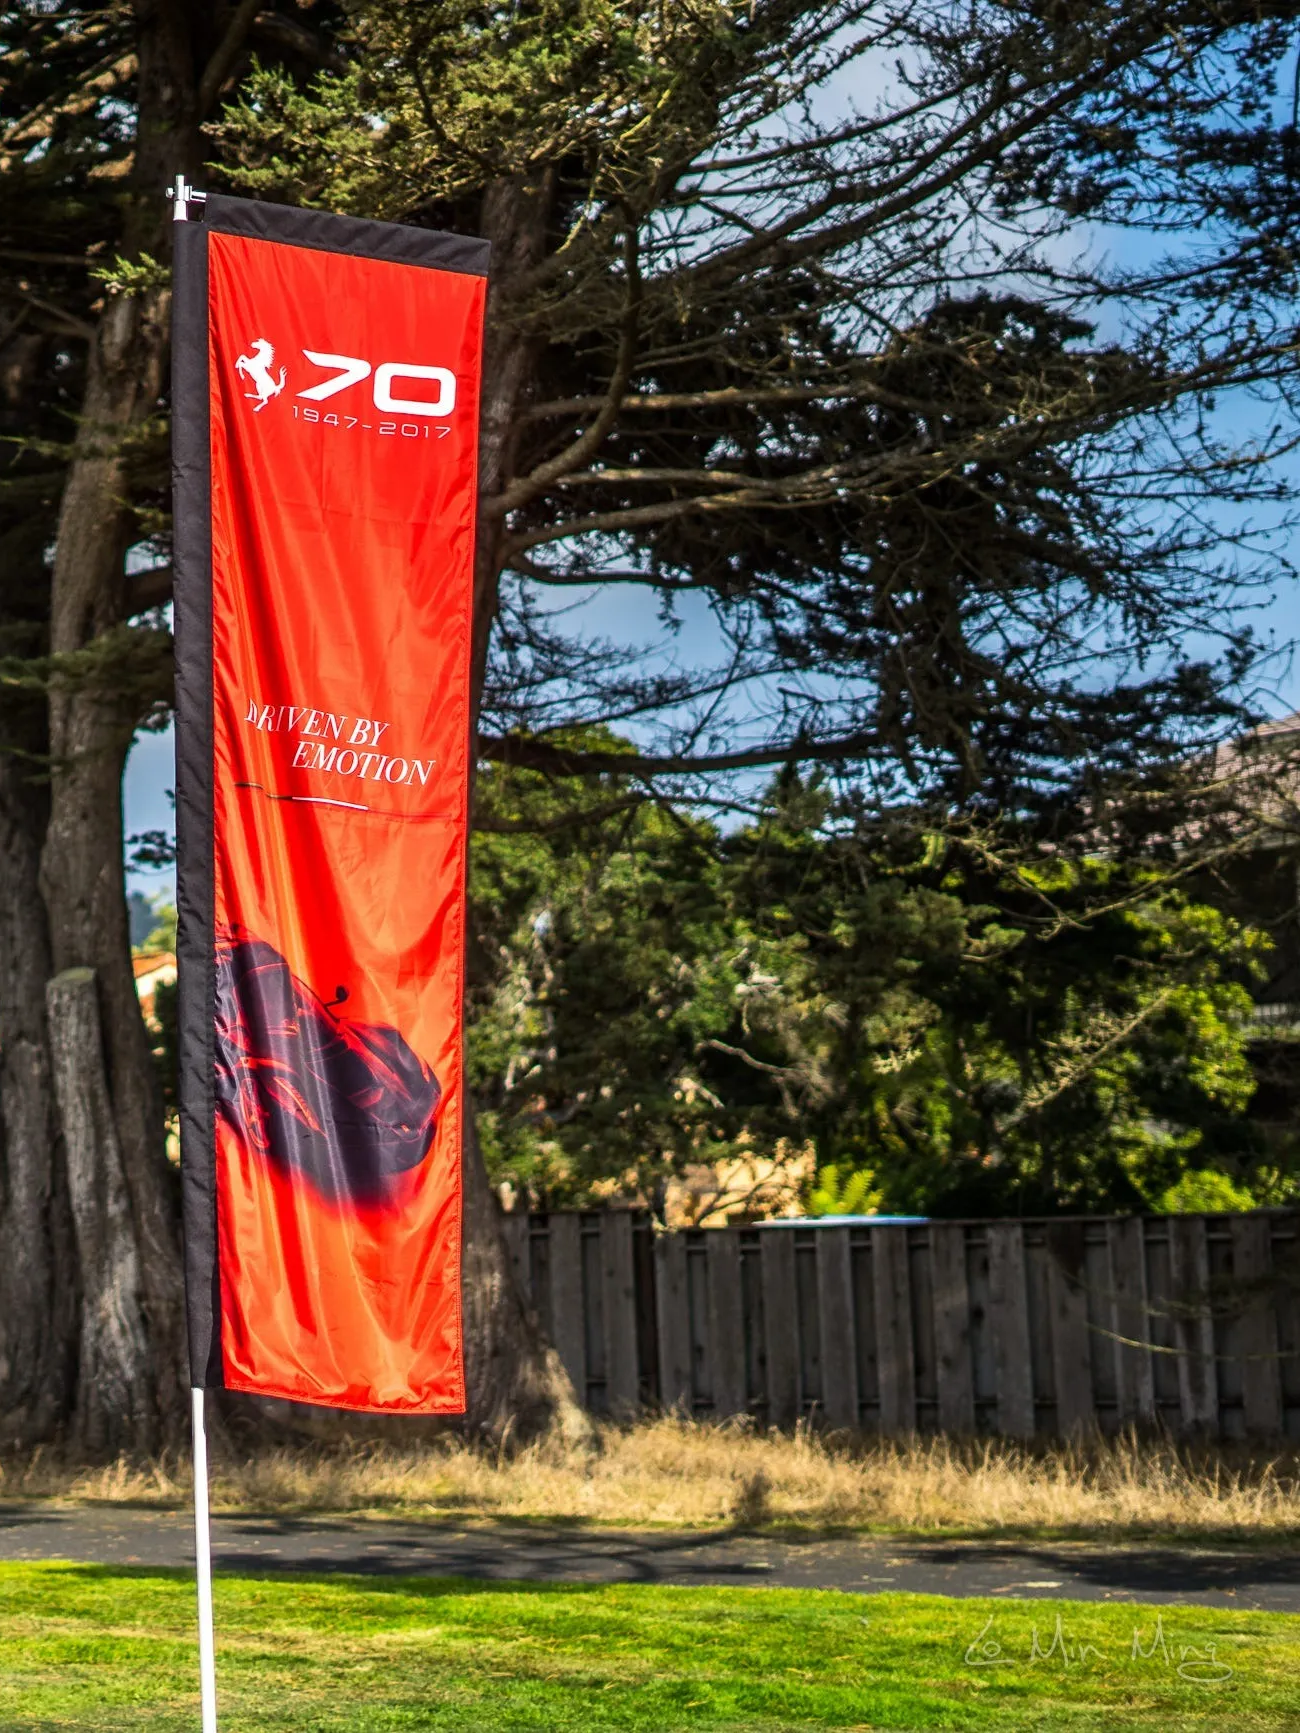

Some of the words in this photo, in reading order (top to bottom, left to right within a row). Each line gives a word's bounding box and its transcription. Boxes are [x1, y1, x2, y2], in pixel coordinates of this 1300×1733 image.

[295, 349, 457, 417] 70
[291, 405, 451, 439] 1947-2017
[244, 699, 348, 741] DRIVEN
[346, 717, 390, 747] BY
[291, 740, 436, 786] EMOTION
